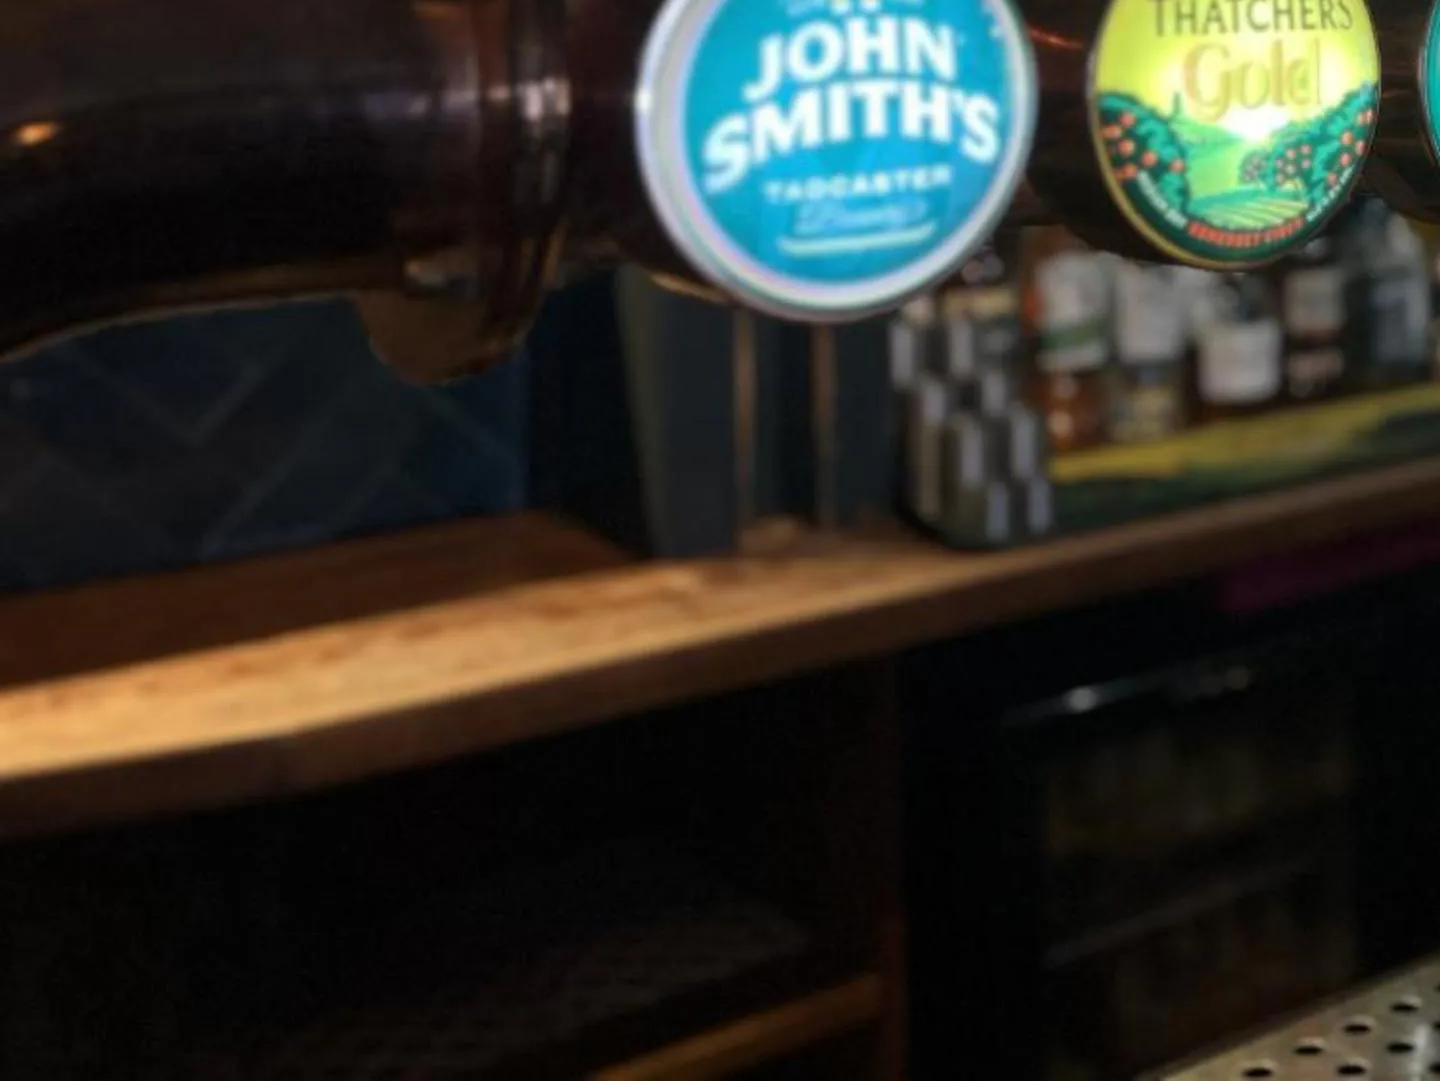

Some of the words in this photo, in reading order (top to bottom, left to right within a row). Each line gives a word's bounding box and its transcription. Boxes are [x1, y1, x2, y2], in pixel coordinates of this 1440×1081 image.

[741, 15, 957, 103] JOHN
[1182, 37, 1323, 123] Gold
[702, 77, 1001, 194] SMITH'S
